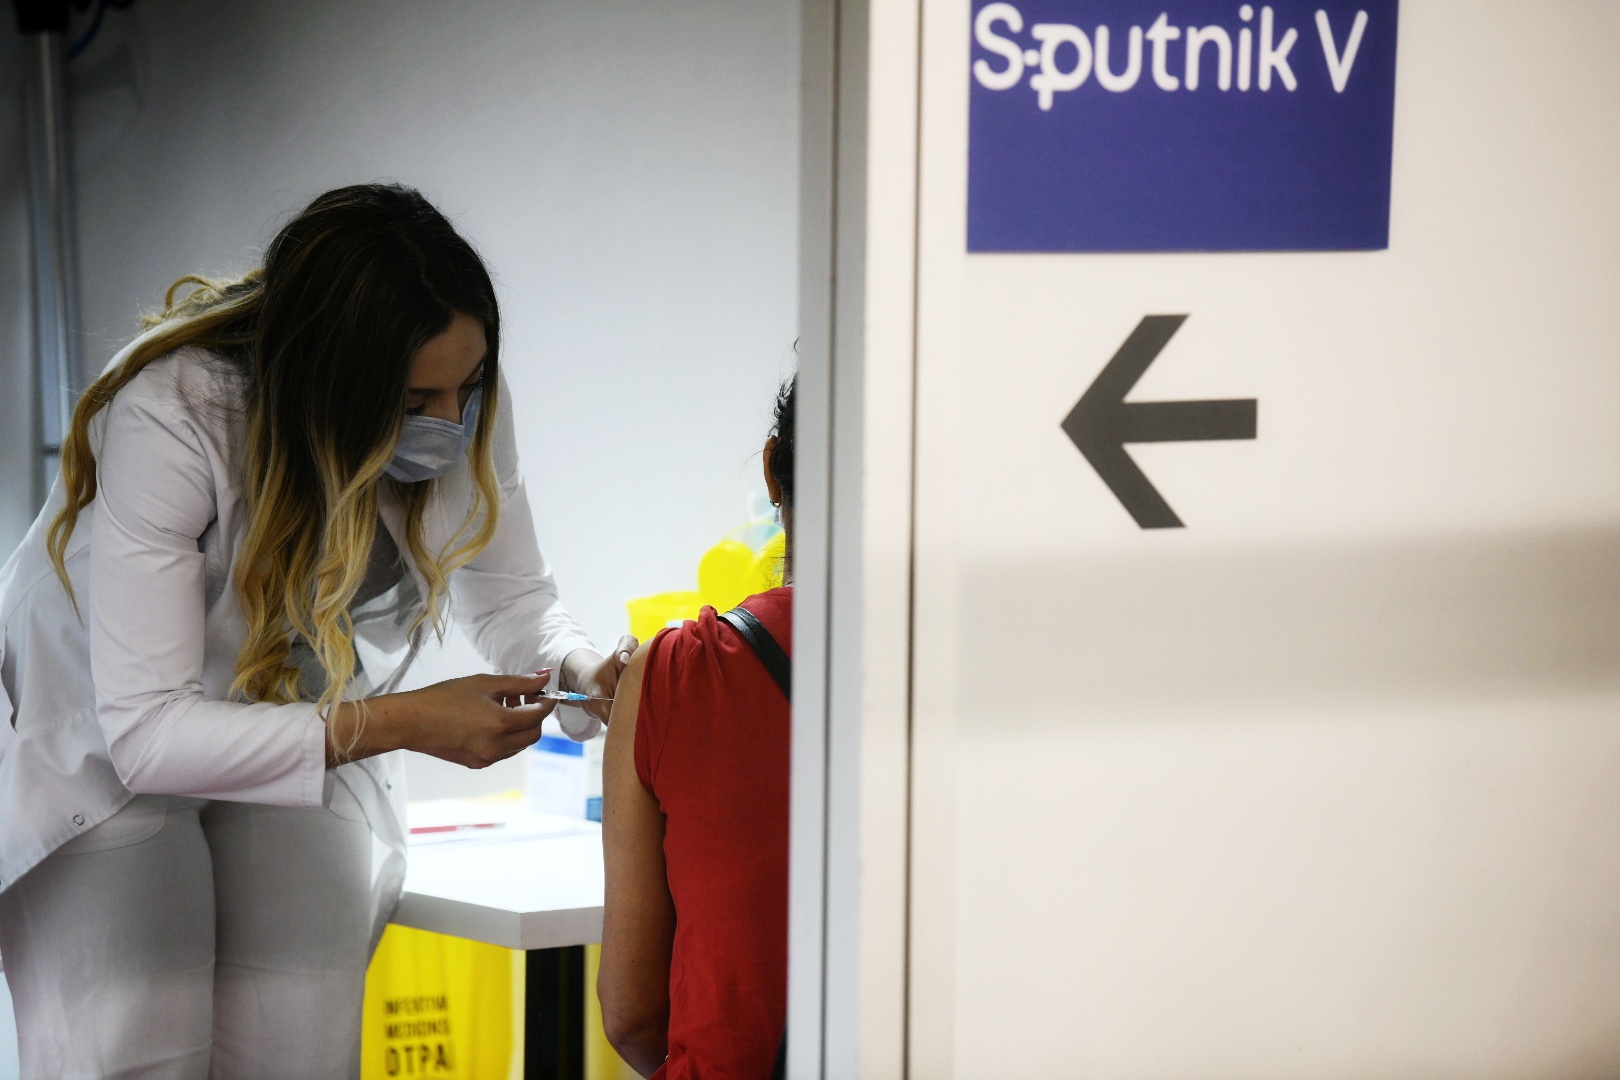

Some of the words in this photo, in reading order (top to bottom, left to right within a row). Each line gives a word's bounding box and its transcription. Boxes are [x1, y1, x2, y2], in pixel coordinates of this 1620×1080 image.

[973, 2, 1299, 112] Sputnik
[1315, 9, 1369, 93] V
[385, 1043, 455, 1077] OTPA
